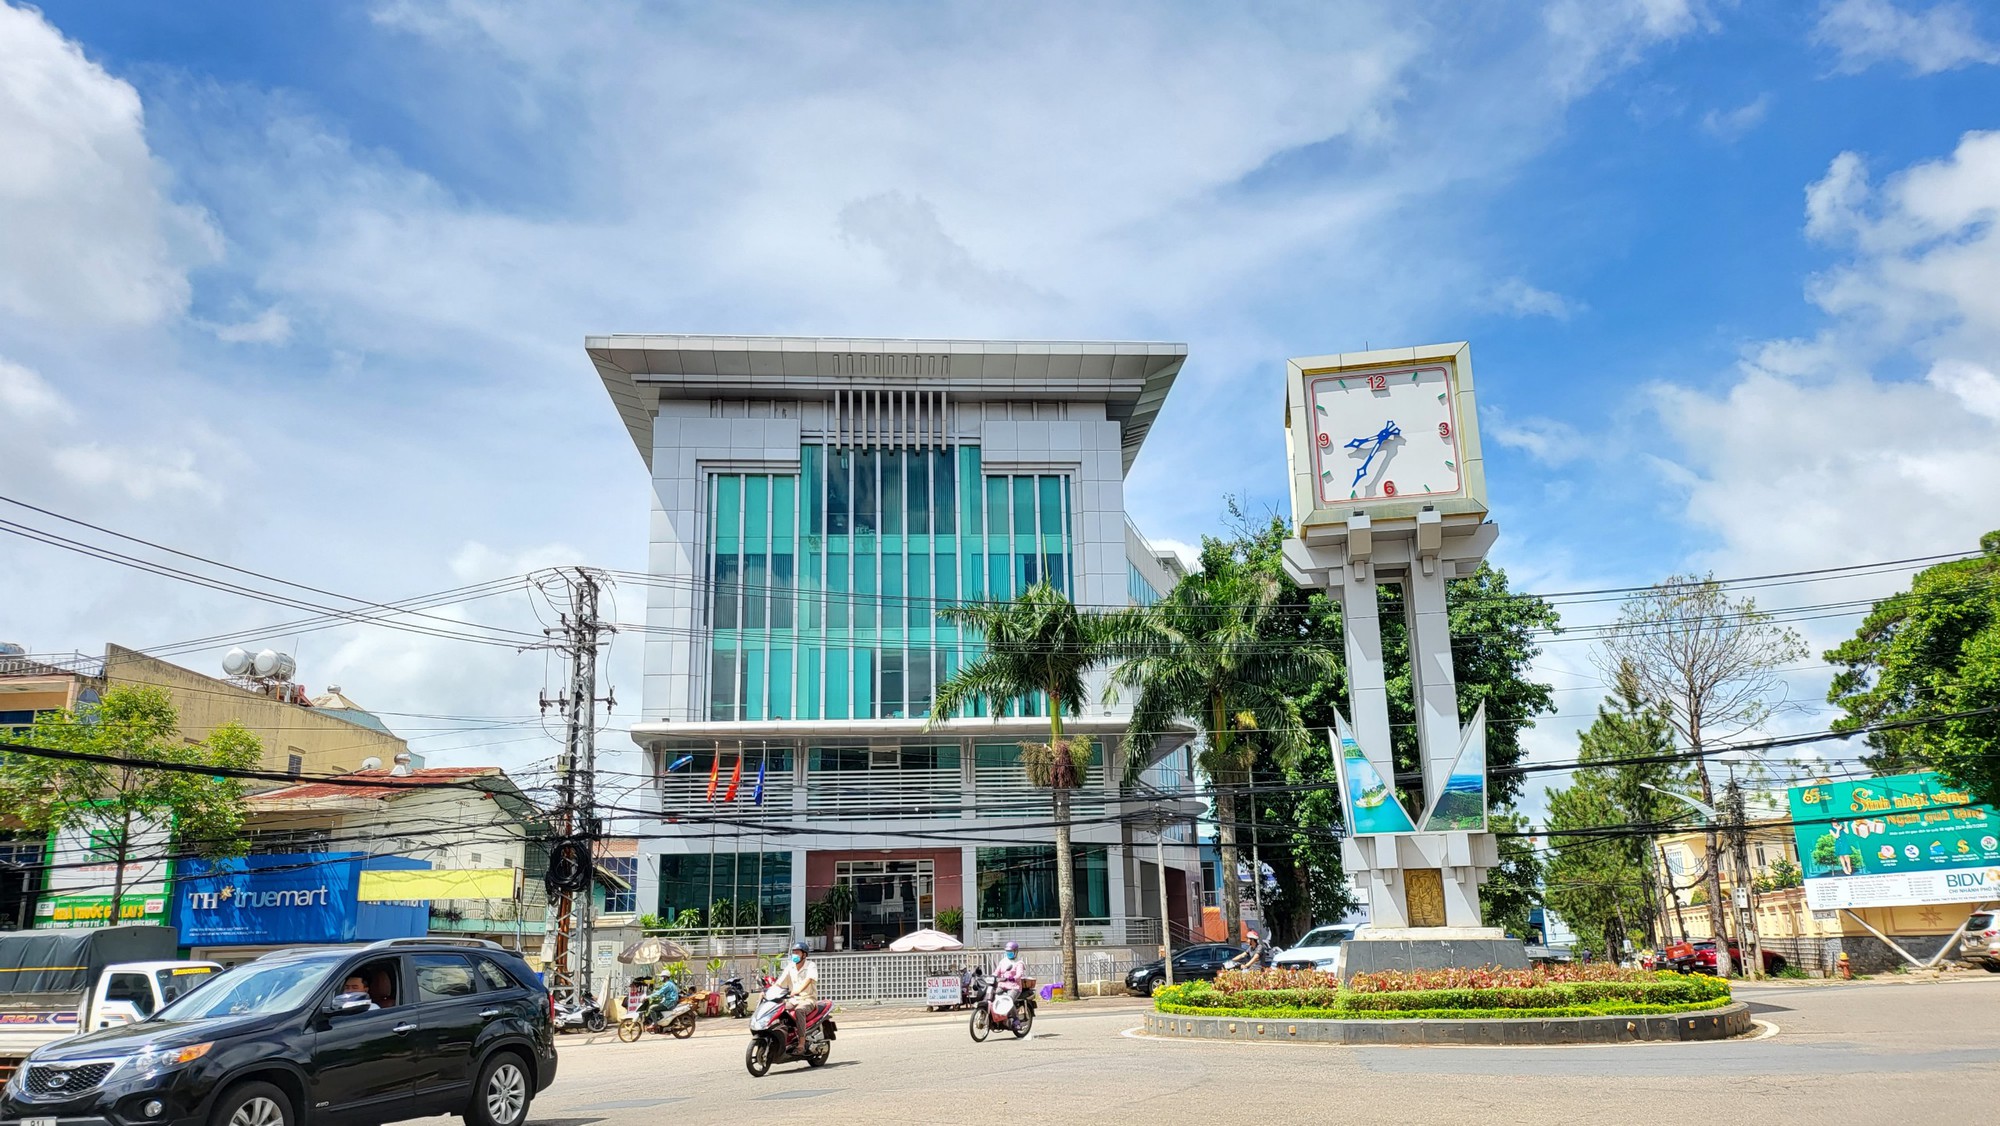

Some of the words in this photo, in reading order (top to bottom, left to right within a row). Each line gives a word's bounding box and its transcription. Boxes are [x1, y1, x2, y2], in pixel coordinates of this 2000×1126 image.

[1367, 375, 1386, 390] 12
[1438, 422, 1450, 437] 3
[1317, 432, 1331, 447] 9
[1383, 480, 1396, 496] 6
[1803, 788, 1820, 804] 65
[1851, 788, 1891, 812] Sinh
[1946, 872, 1985, 887] BIDV
[188, 892, 219, 910] TH
[234, 885, 328, 908] truemart
